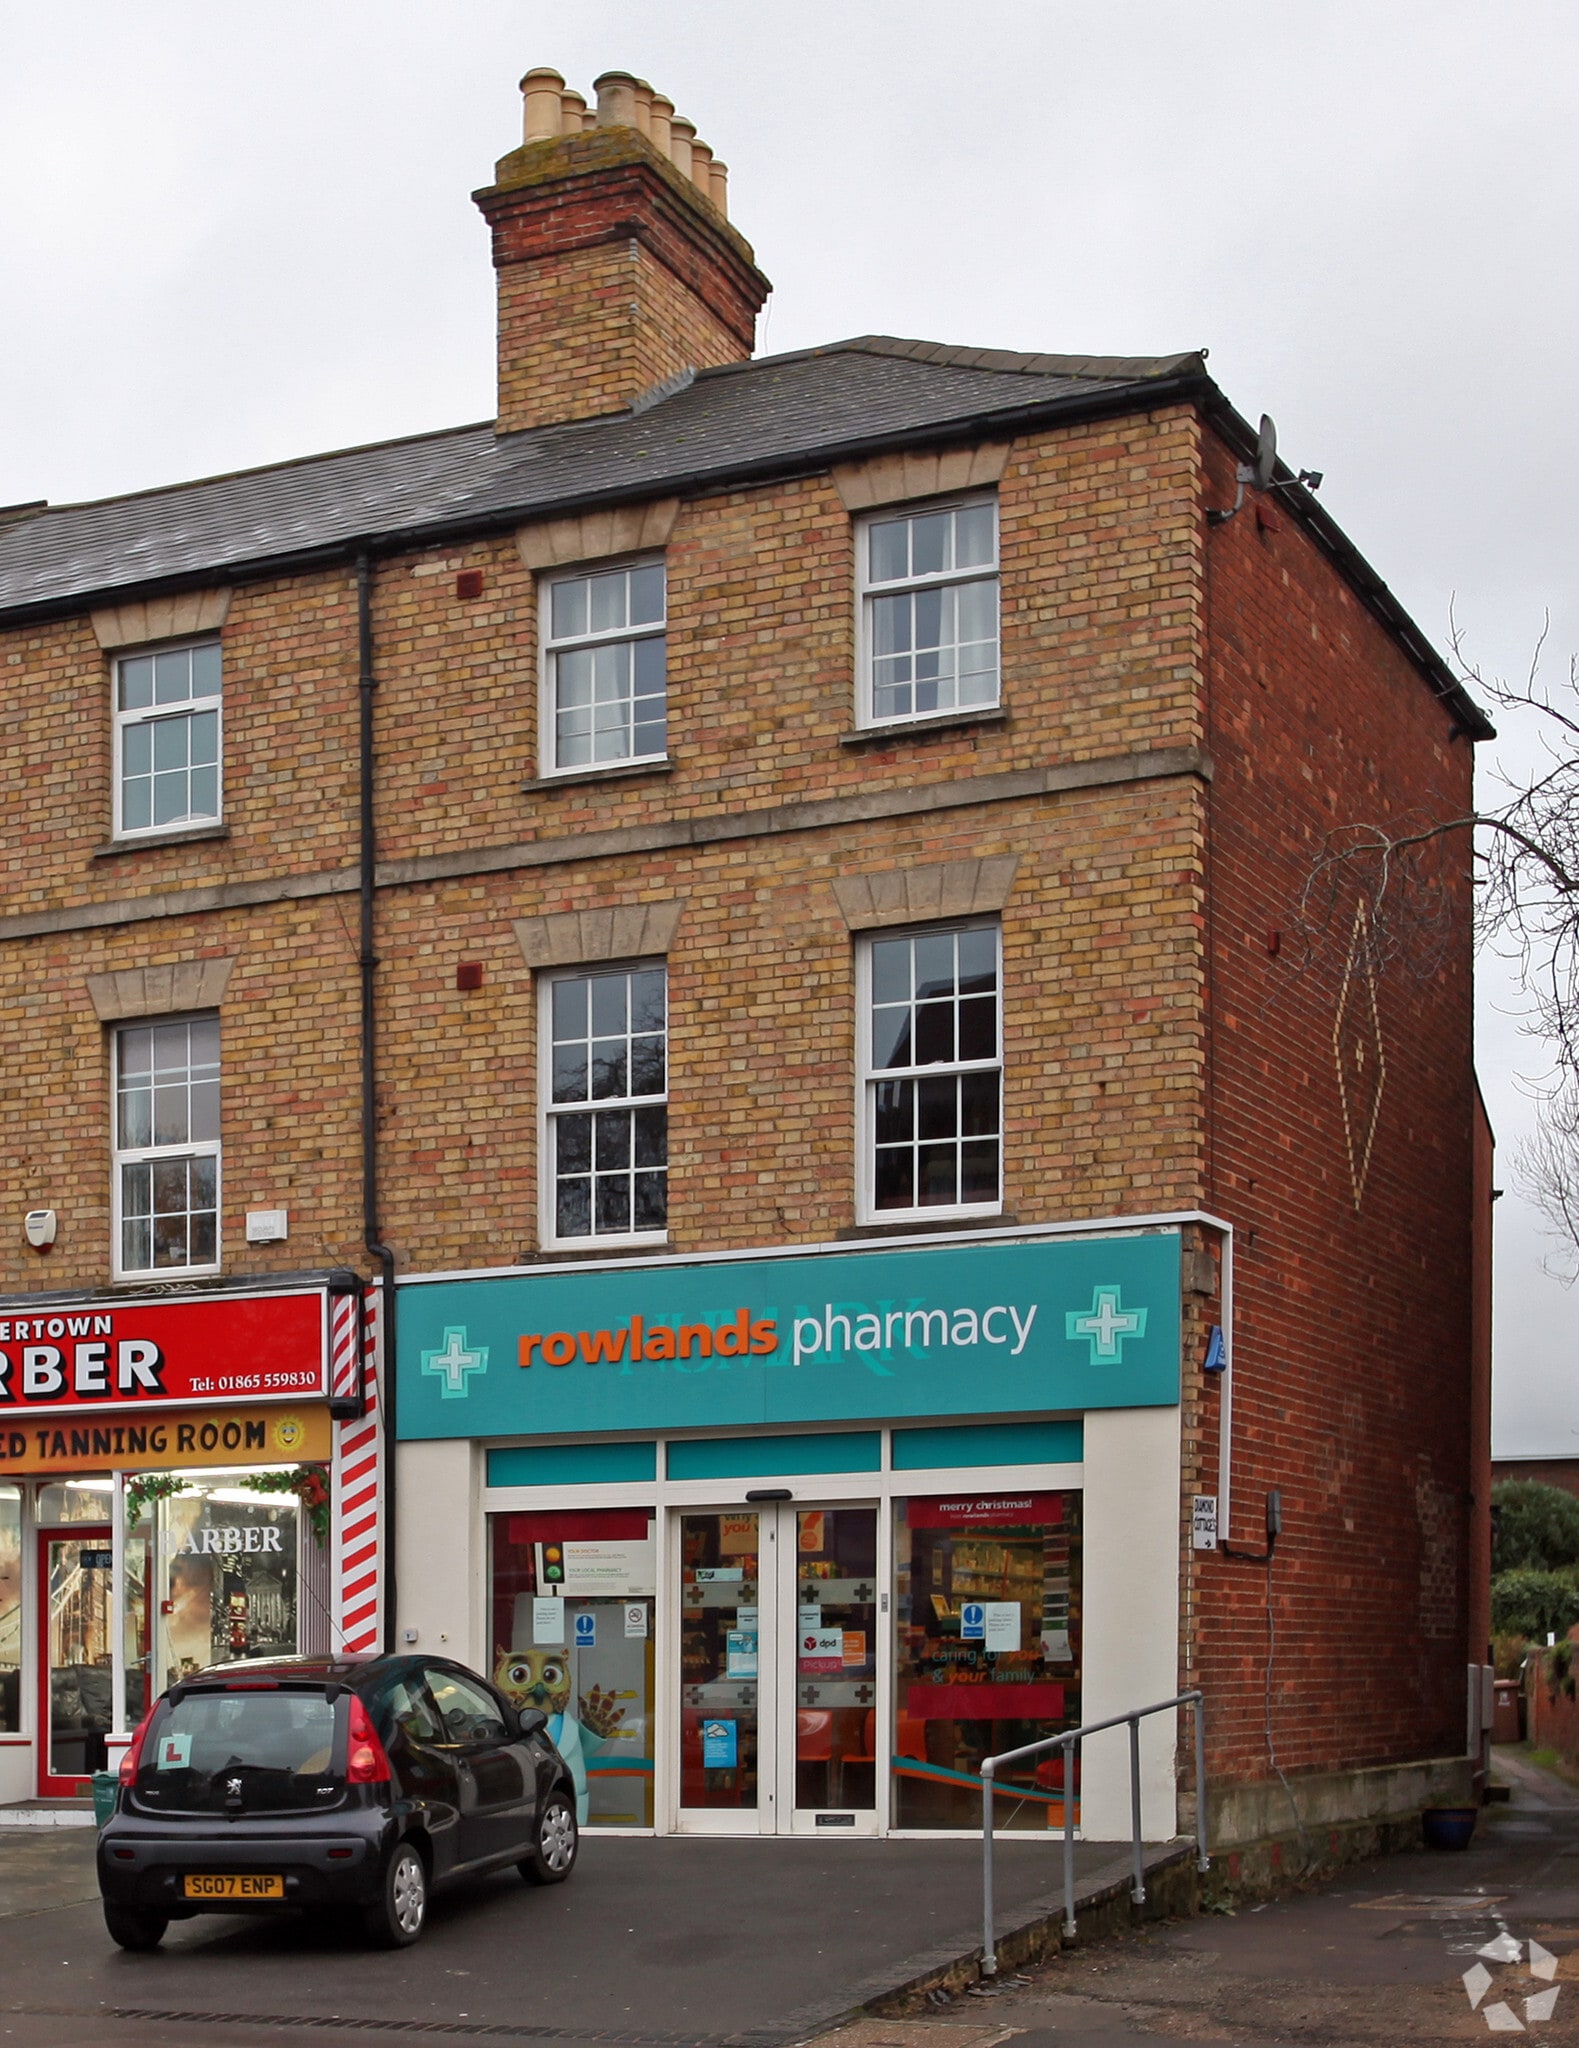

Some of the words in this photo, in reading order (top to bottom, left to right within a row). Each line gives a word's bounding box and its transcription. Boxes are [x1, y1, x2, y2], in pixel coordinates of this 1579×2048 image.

[518, 1308, 778, 1367] rowlands
[794, 1303, 1038, 1366] pharmacy
[0, 1340, 160, 1395] BER
[190, 1377, 214, 1392] Tel:
[218, 1374, 261, 1390] 01865
[264, 1370, 316, 1387] 559830
[37, 1425, 167, 1458] TANNING
[178, 1420, 266, 1451] ROOM
[939, 1502, 973, 1513] merry
[976, 1499, 1032, 1511] christmas!
[723, 1523, 751, 1537] you
[159, 1526, 283, 1556] BARBER
[820, 1639, 837, 1649] dpd
[803, 1660, 838, 1670] Pickup
[932, 1648, 977, 1664] caring
[932, 1668, 944, 1683] &
[948, 1670, 988, 1686] your
[990, 1667, 1035, 1685] family
[166, 1743, 182, 1762] L
[192, 1877, 236, 1894] SG07
[241, 1876, 275, 1893] ENP
